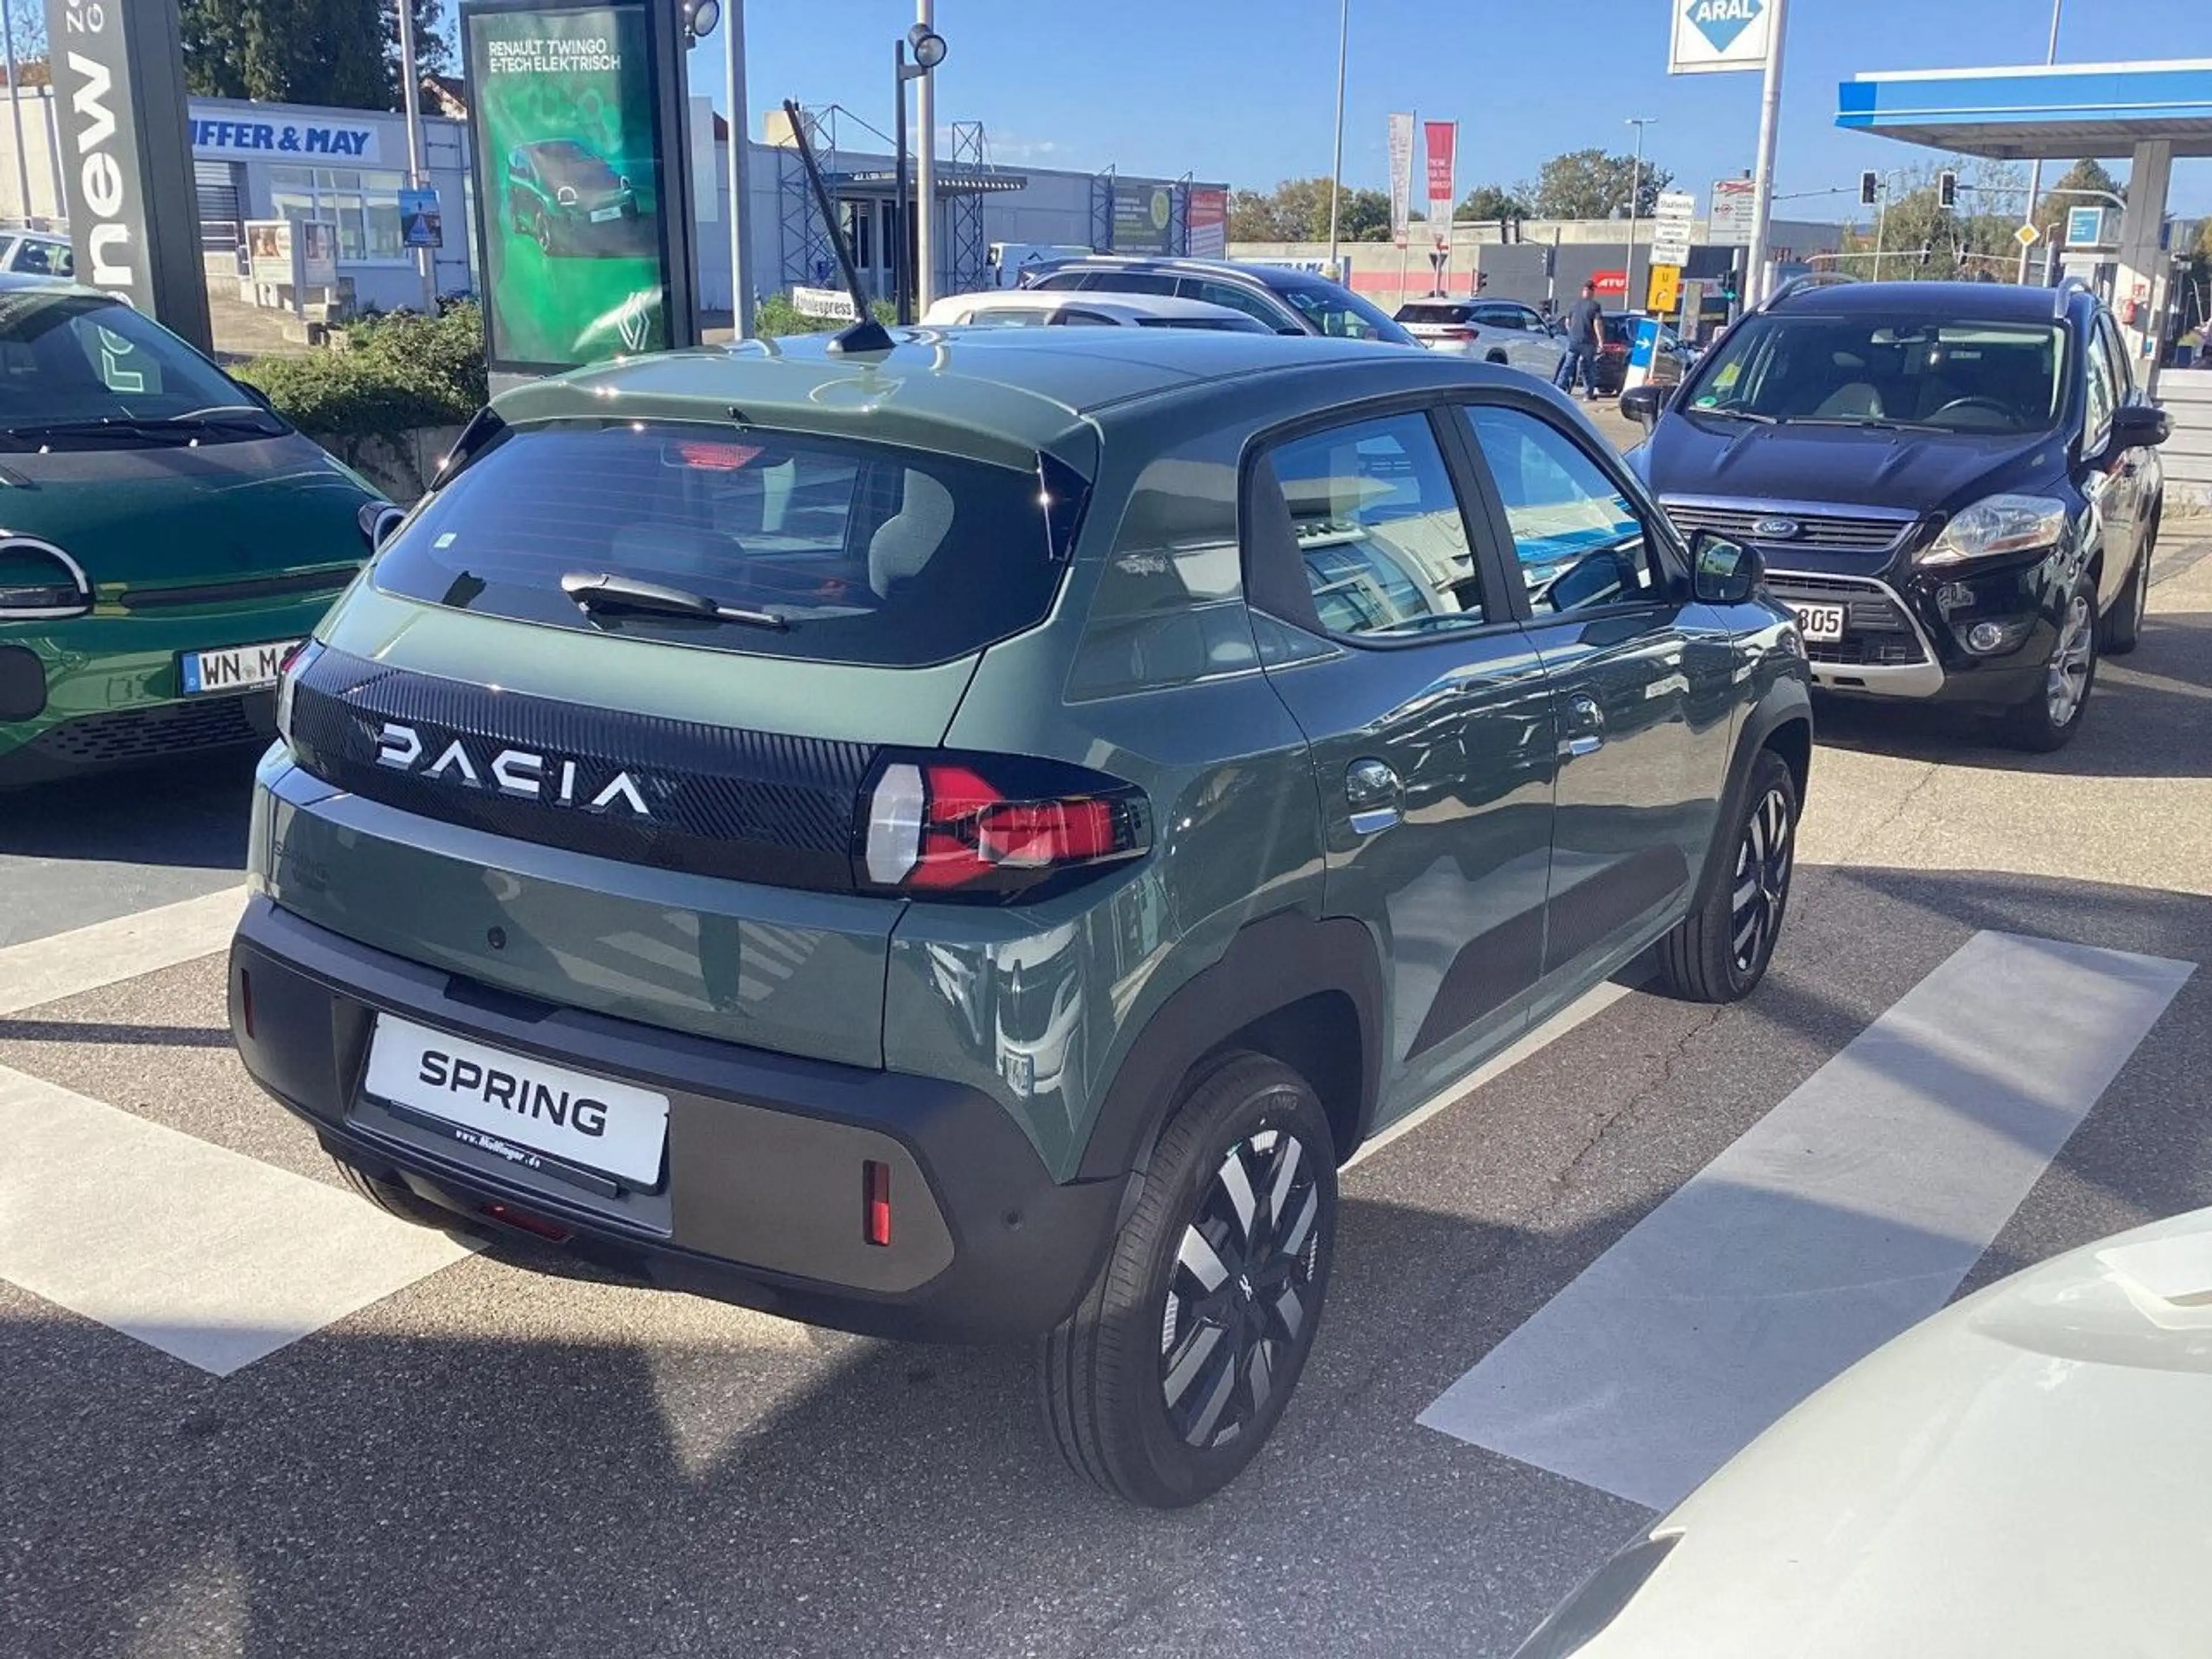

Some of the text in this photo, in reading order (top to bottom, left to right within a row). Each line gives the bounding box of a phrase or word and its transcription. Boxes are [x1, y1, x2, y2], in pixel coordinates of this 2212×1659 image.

[1695, 0, 1755, 22] ARAL
[488, 38, 607, 56] RENAULT TWINGO
[490, 55, 622, 74] E-TECH ELEKTRISCH
[278, 126, 301, 152] &
[305, 127, 370, 156] MAY
[1598, 278, 1626, 287] ATU
[1798, 608, 1840, 634] 805
[202, 653, 241, 685] WN
[377, 722, 651, 814] DACIA
[419, 1050, 608, 1137] SPRING
